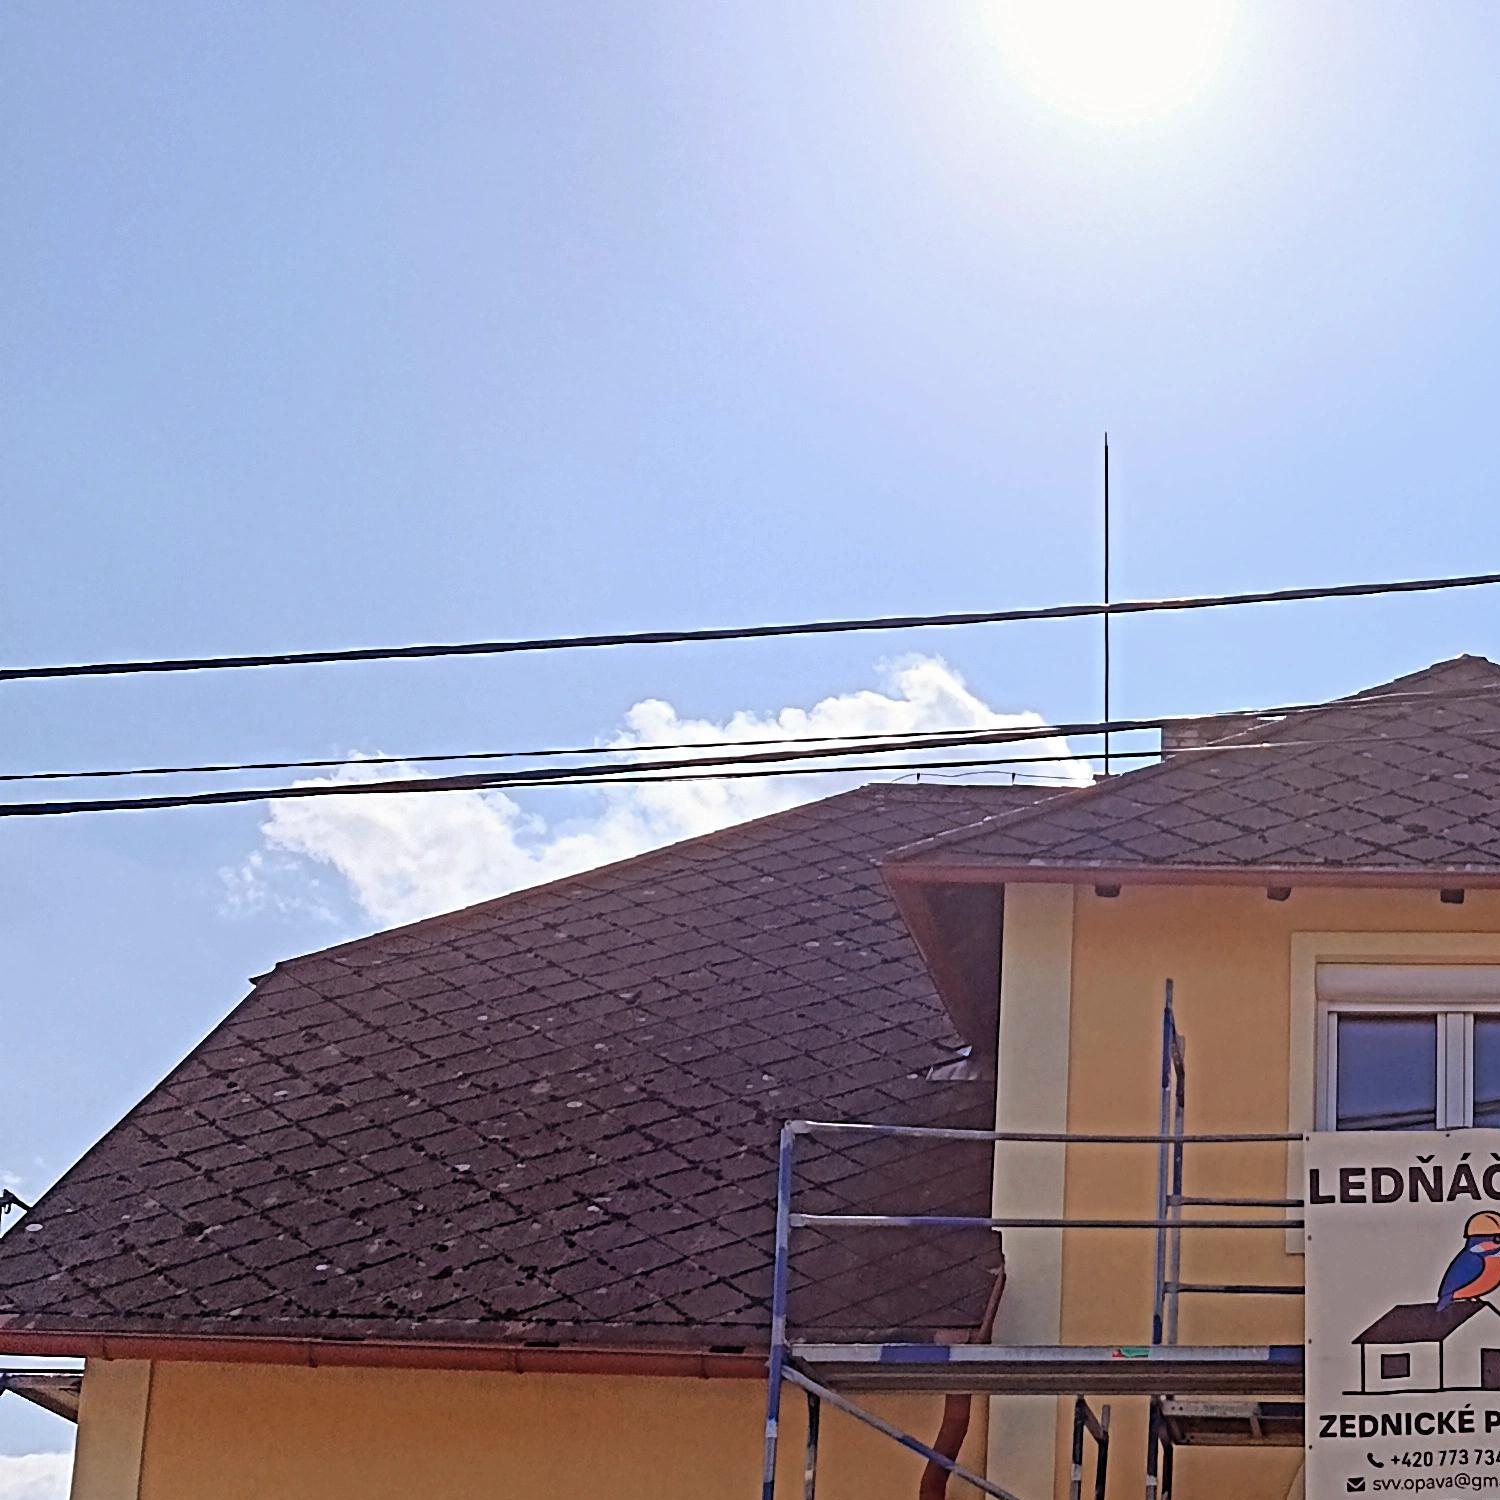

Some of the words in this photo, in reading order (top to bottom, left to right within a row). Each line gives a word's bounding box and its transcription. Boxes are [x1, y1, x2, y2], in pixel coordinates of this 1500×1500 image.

[1319, 1404, 1475, 1438] ZEDNICKÉ
[1391, 1452, 1433, 1467] +420
[1438, 1449, 1469, 1466] 773
